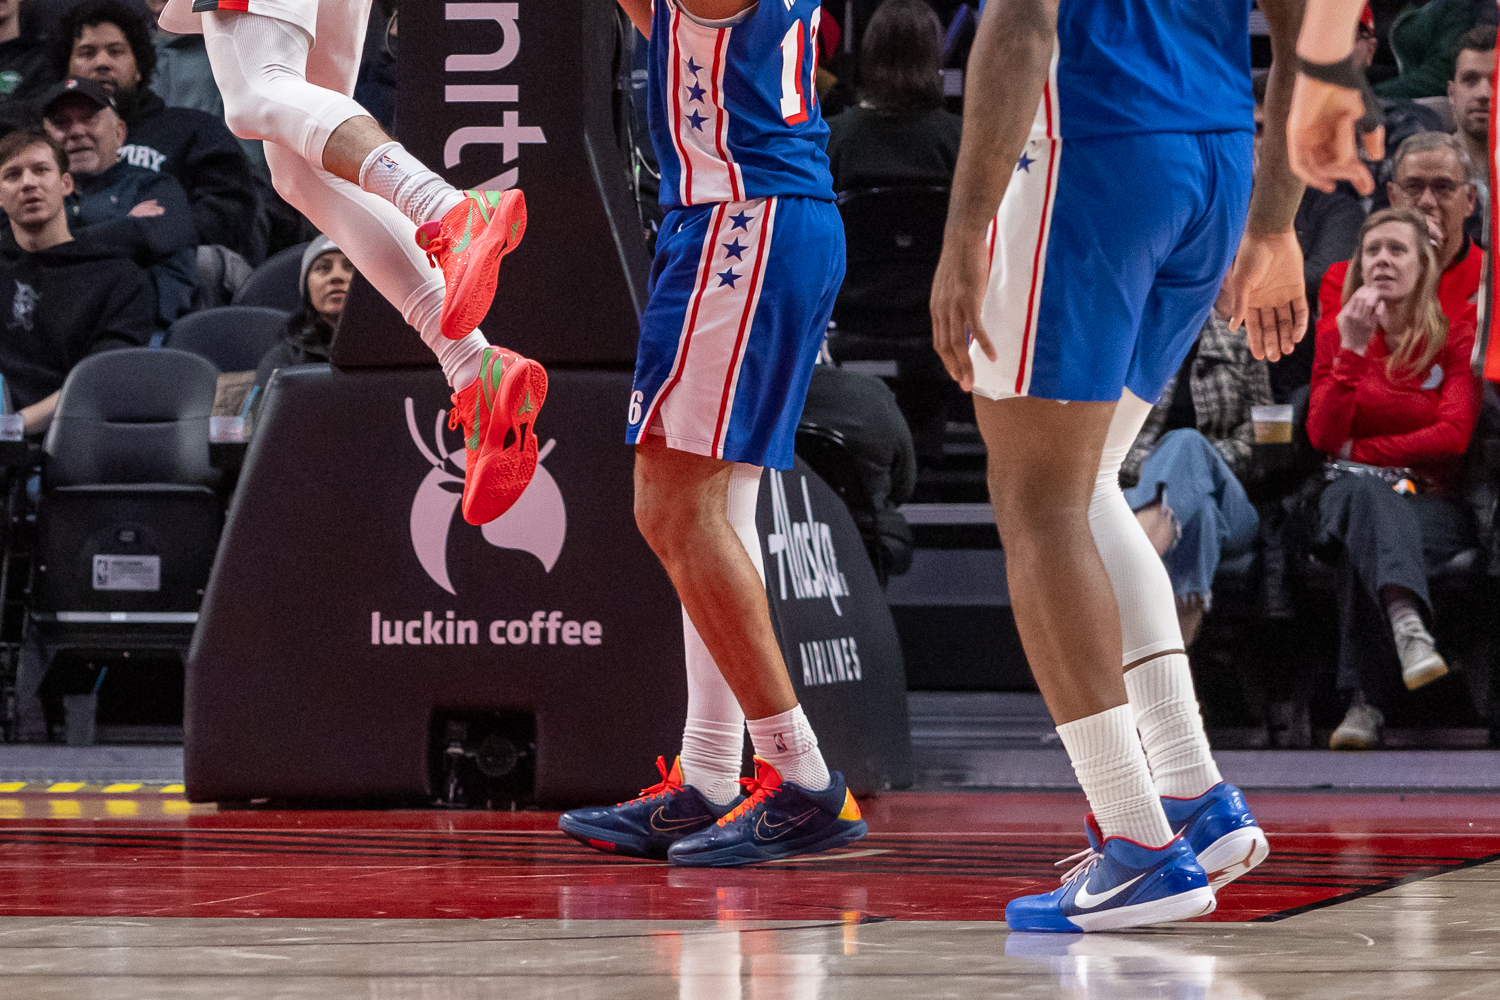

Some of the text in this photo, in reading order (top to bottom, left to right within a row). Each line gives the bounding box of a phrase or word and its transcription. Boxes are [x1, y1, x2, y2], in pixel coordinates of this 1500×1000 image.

[628, 390, 644, 426] 6
[371, 611, 603, 645] luckin coffee
[800, 637, 862, 686] AIRLINES
